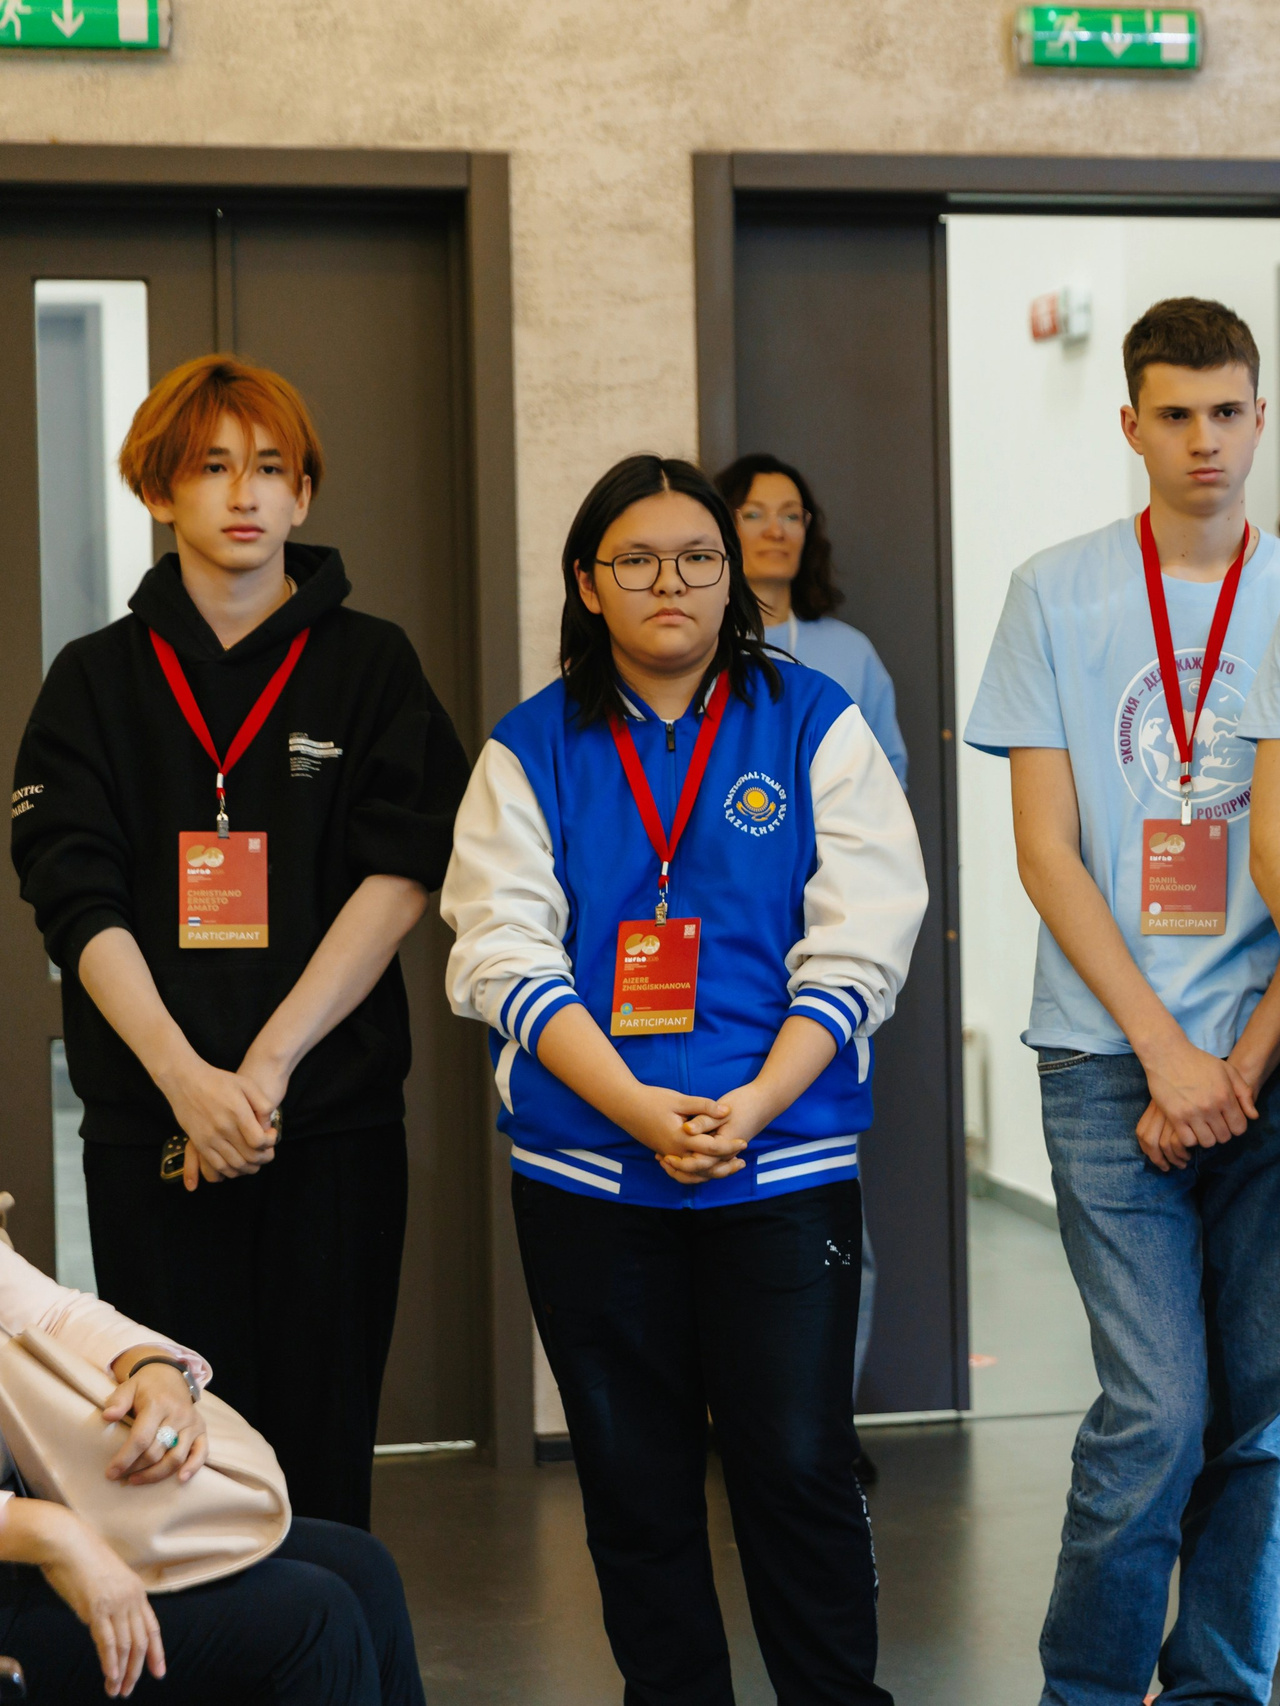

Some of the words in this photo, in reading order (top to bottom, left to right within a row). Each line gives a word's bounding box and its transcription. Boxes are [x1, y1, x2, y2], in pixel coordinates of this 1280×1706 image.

[1120, 696, 1141, 765] ЭКОЛОГИЯ
[760, 772, 781, 792] TEAM
[1148, 884, 1197, 892] DYAKONOV
[1148, 918, 1218, 928] PARTICIPIANT
[187, 931, 260, 941] PARTICIPIANT
[622, 976, 650, 984] AIZERE
[620, 1016, 688, 1028] PARTICIPIANT
